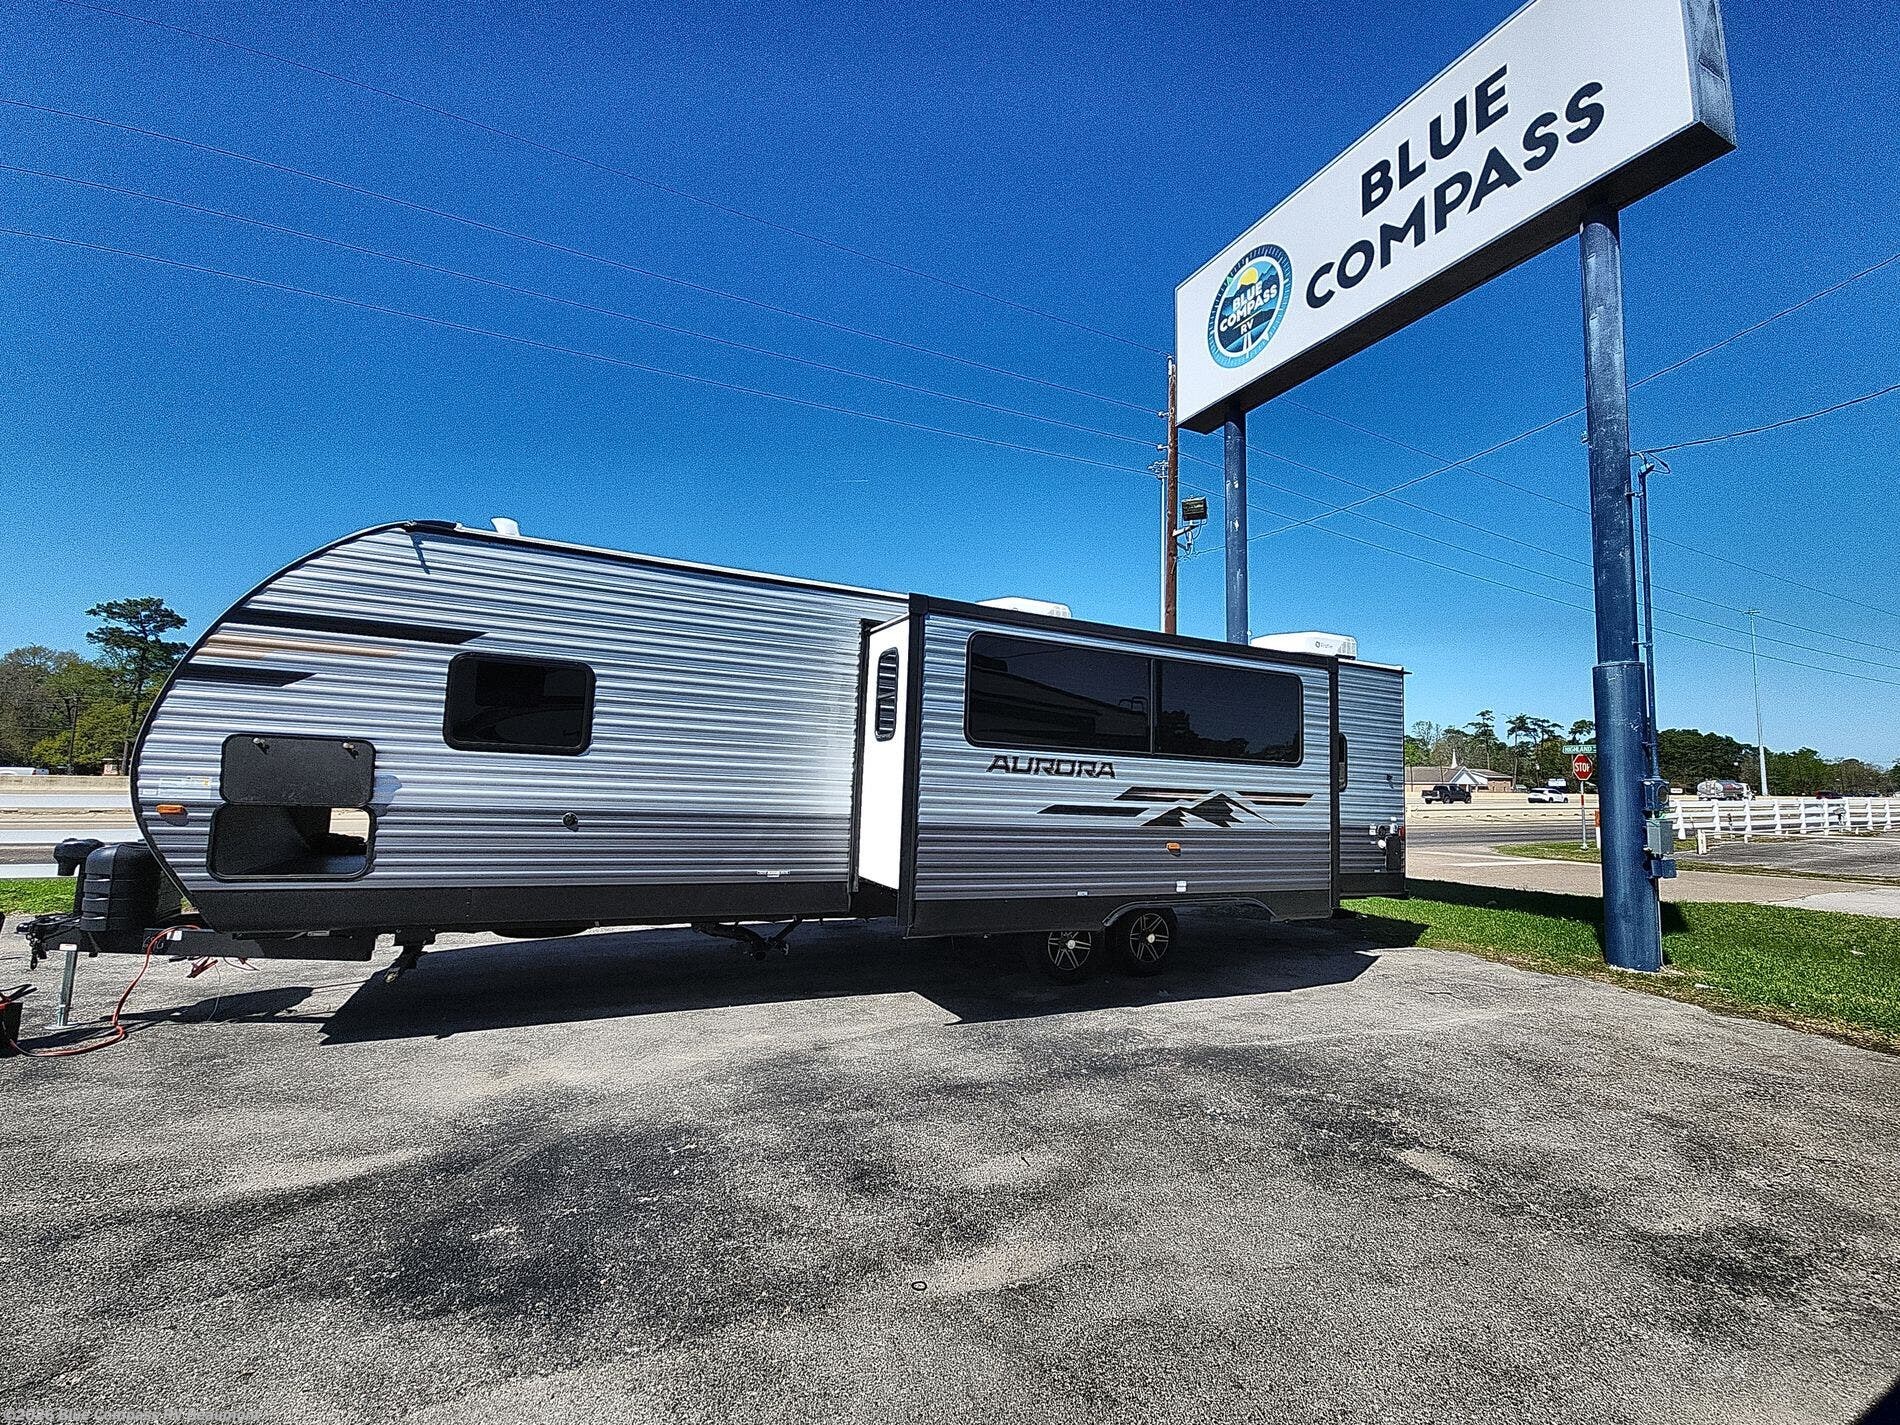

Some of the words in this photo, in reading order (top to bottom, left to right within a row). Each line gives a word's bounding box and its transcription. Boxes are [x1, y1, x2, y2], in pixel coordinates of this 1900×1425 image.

[1361, 64, 1509, 217] BLUE
[1305, 82, 1606, 309] COMPASS
[1219, 284, 1278, 332] COMPASS
[1232, 281, 1263, 312] BLUE
[1240, 318, 1255, 335] RV
[1564, 745, 1592, 753] HIGHLAND
[985, 754, 1116, 779] AURORA
[1574, 763, 1590, 772] STOP
